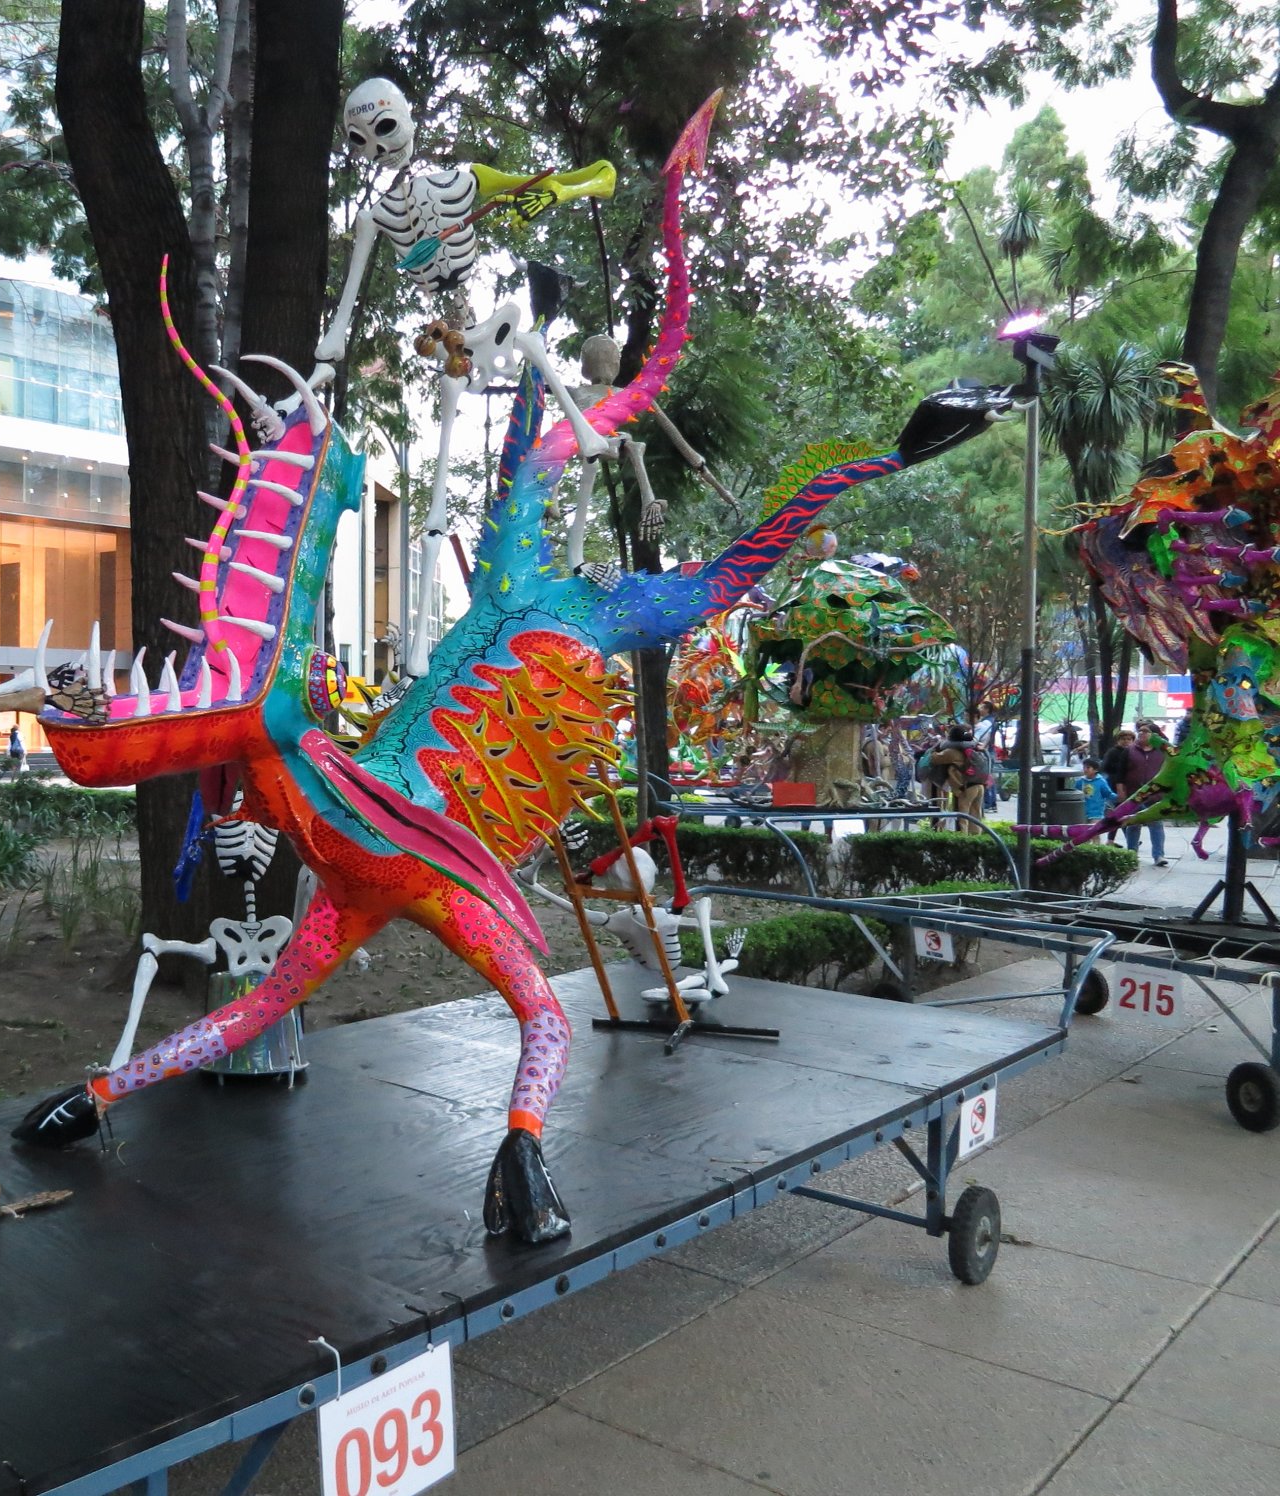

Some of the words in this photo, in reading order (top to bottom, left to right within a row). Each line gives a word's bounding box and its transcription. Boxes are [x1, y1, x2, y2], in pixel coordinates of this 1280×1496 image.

[348, 102, 375, 118] PEDRO
[1119, 977, 1175, 1017] 215
[335, 1388, 444, 1496] 093
